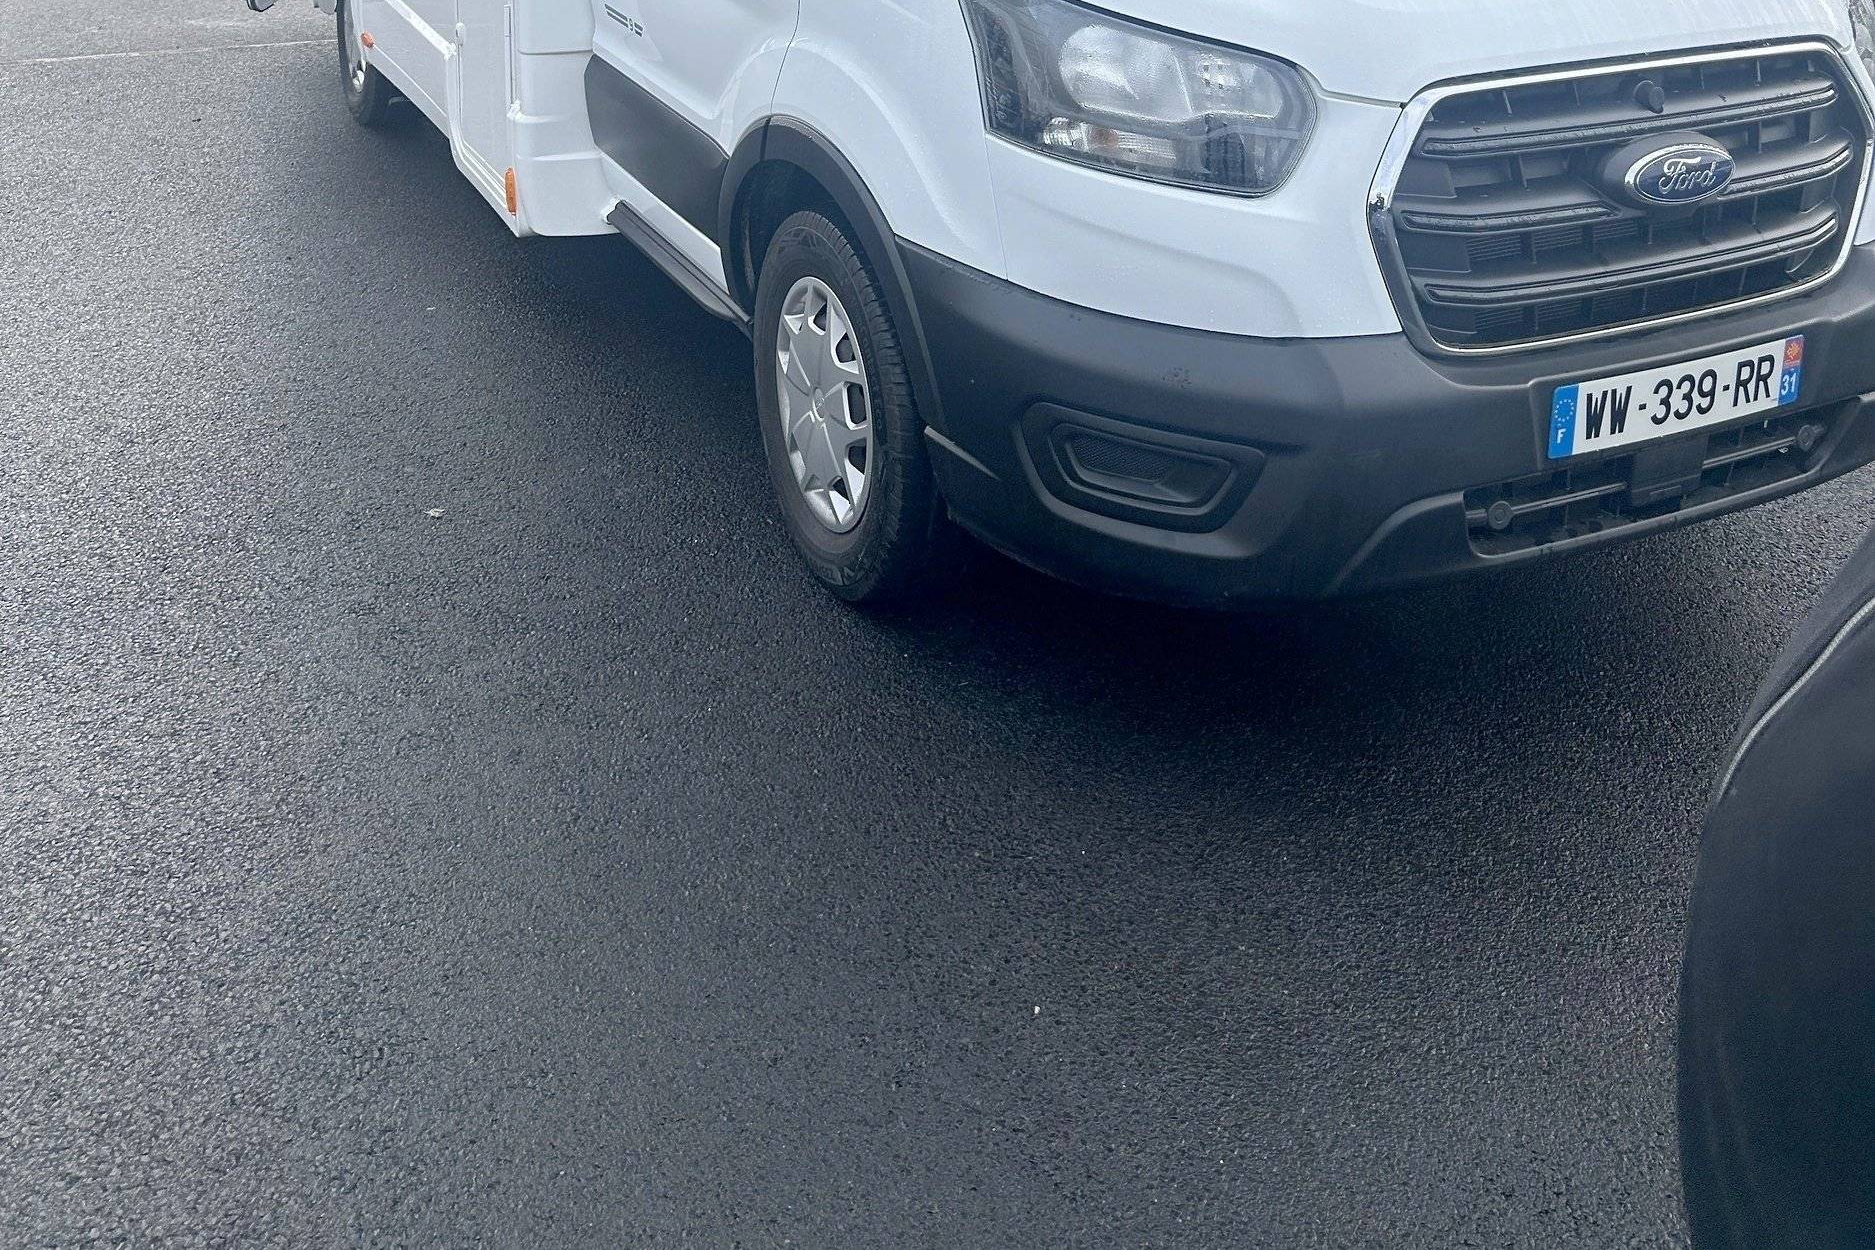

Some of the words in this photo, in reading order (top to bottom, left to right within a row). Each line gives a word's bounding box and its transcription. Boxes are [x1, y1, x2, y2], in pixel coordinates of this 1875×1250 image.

[1659, 157, 1717, 194] Ford
[1557, 428, 1567, 444] F
[1585, 354, 1775, 440] WW-339-RR
[1781, 372, 1797, 396] 31
